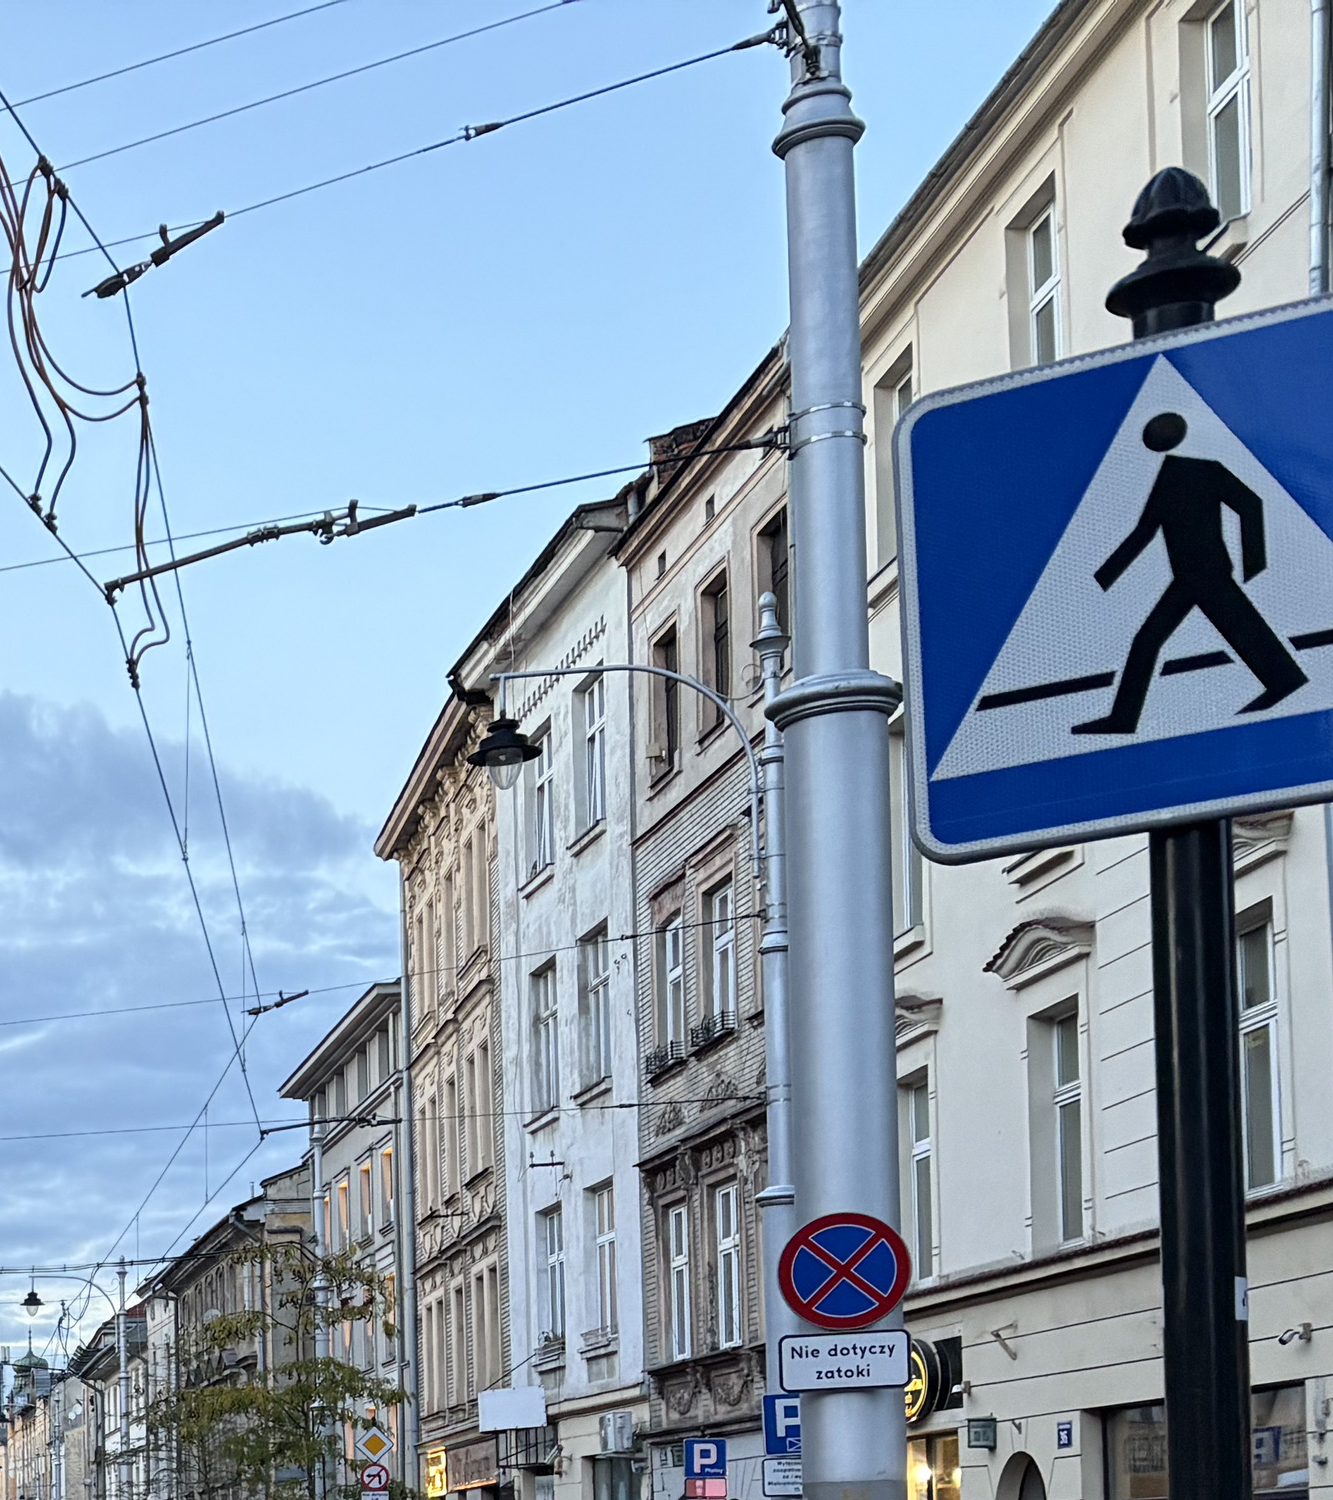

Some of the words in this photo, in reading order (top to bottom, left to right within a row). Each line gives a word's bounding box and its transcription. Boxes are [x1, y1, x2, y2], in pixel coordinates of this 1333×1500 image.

[791, 1345, 821, 1360] Nie
[827, 1342, 896, 1360] dotyczy
[815, 1363, 872, 1381] zatoki
[693, 1442, 718, 1474] P
